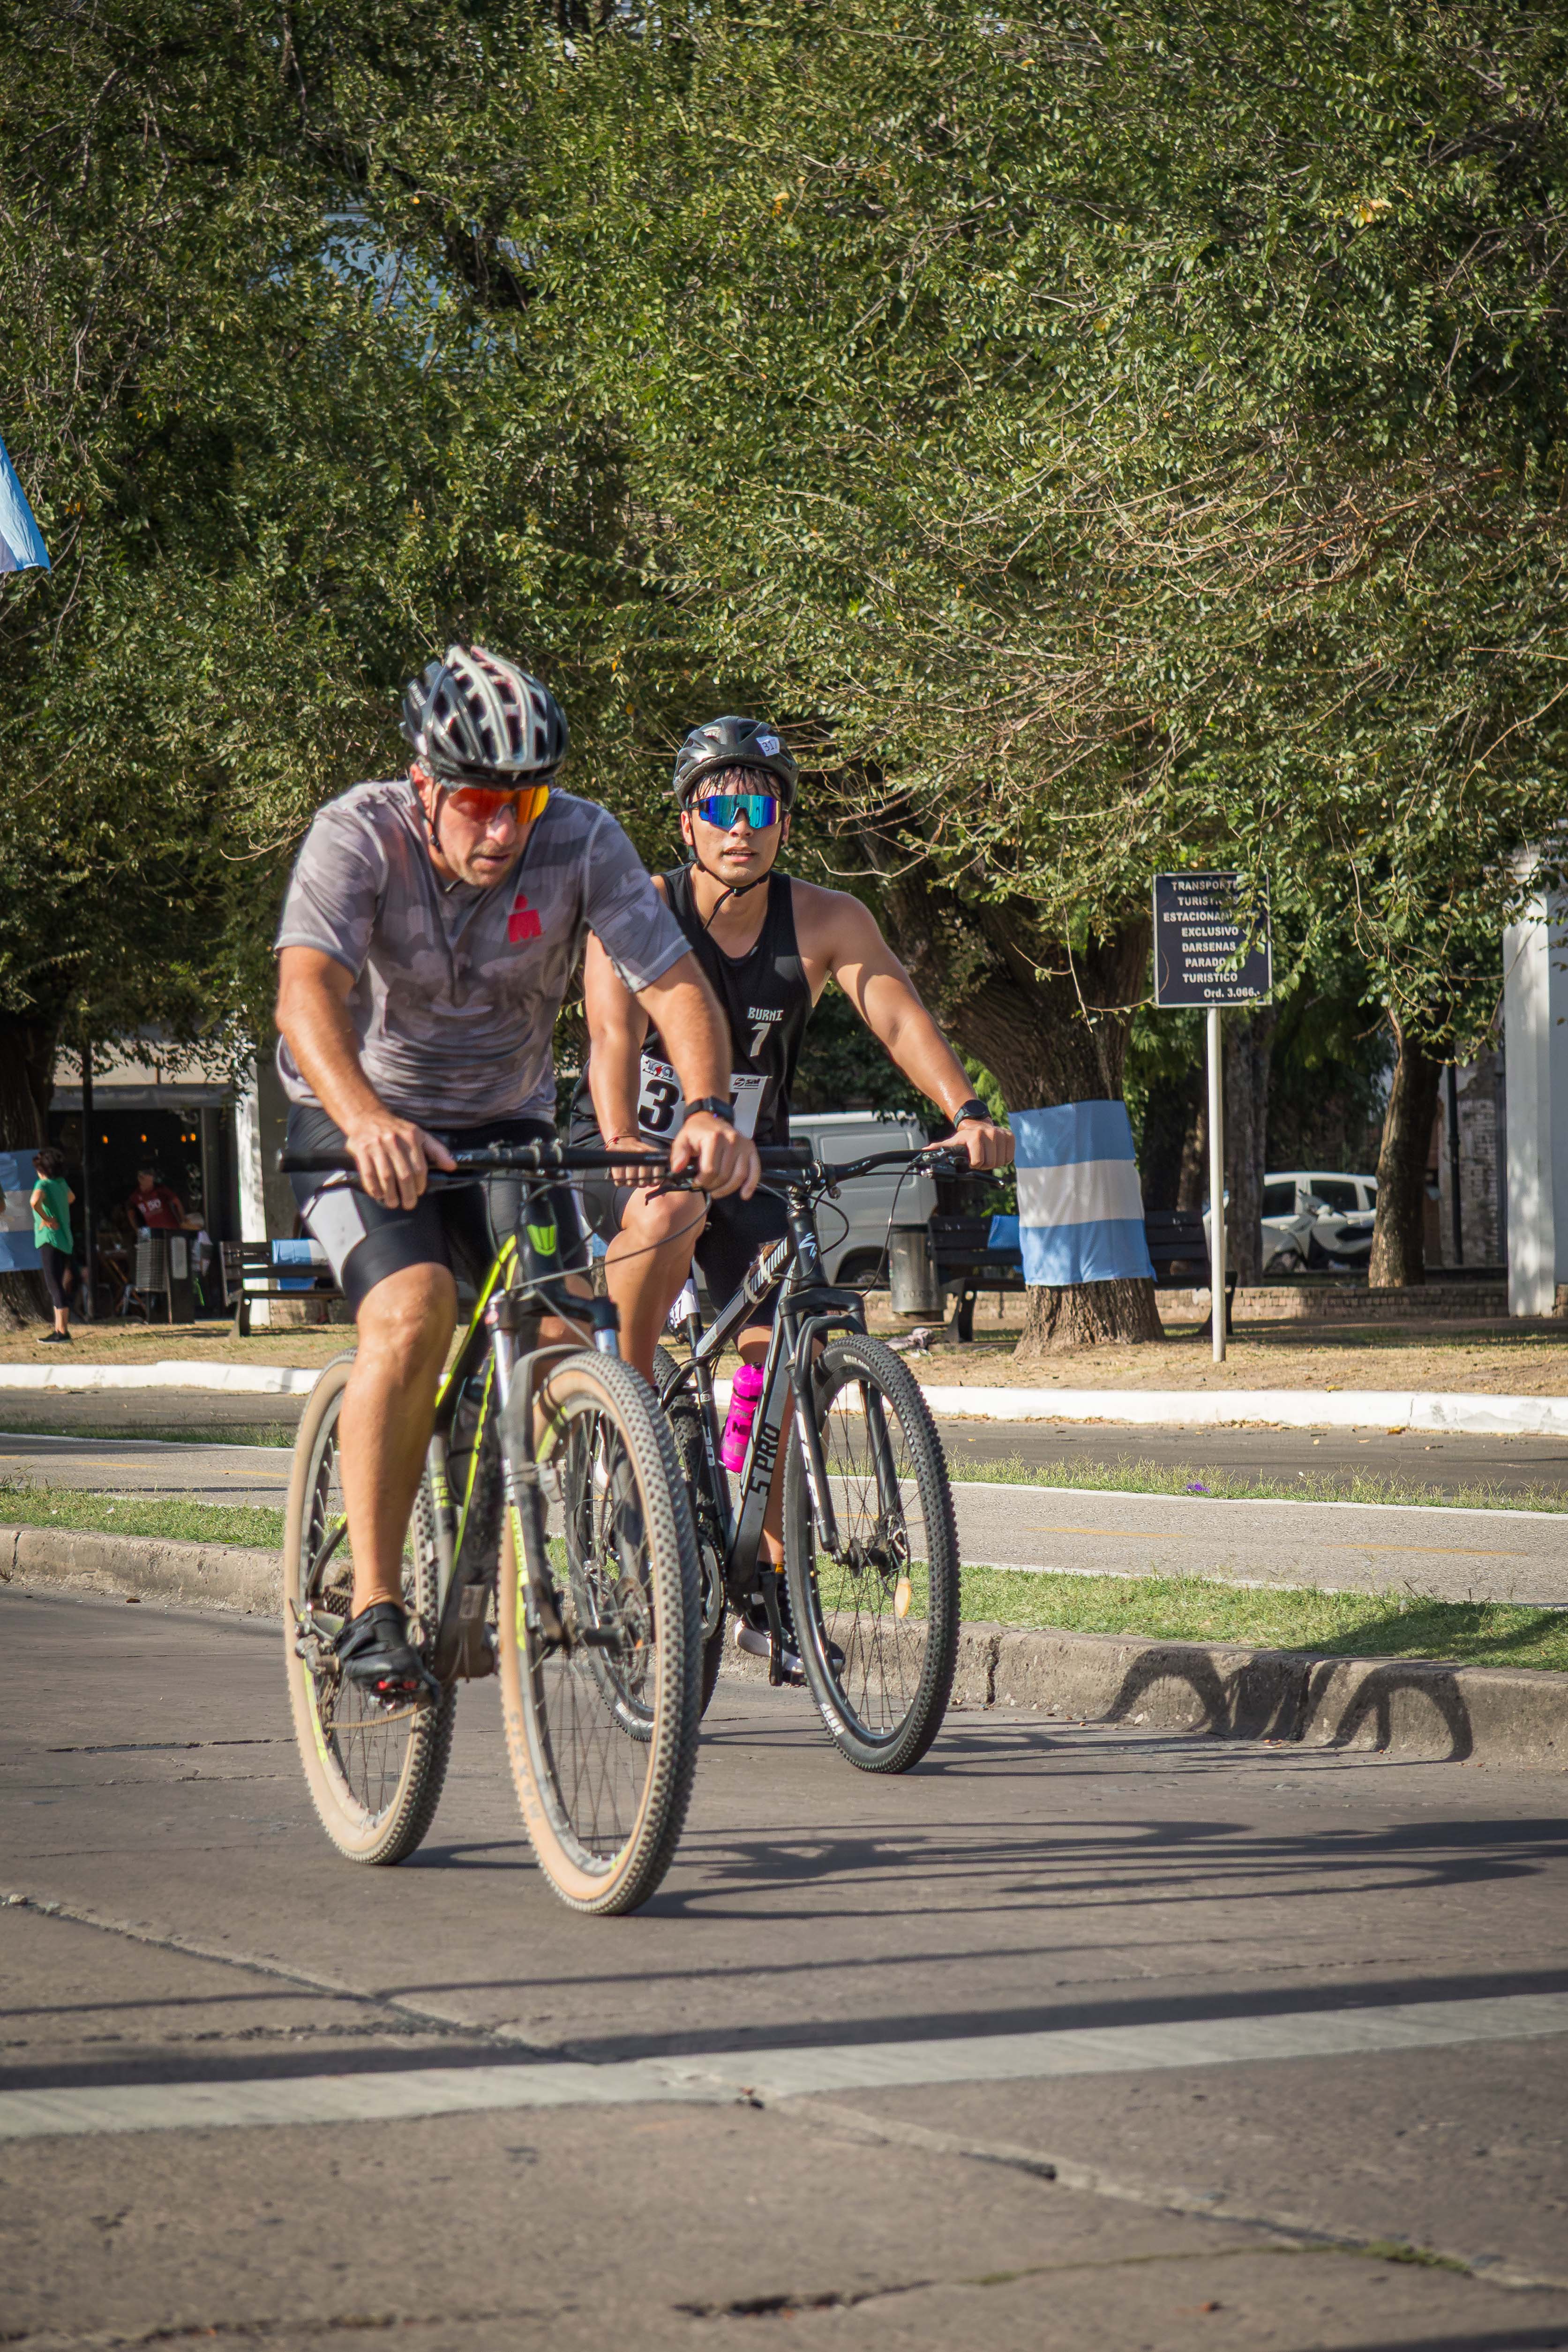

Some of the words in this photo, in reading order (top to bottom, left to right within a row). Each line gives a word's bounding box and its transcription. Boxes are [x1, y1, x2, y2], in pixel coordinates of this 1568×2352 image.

[1181, 926, 1239, 937] EXCLUSIVO
[1182, 942, 1236, 952] DARSENAS
[1185, 957, 1227, 967] PARADO
[1182, 972, 1238, 983] TURISTICO
[1204, 988, 1224, 998] Ord.
[748, 1006, 784, 1021] BURNI
[750, 1022, 772, 1057] 7
[752, 1422, 781, 1473] PRO
